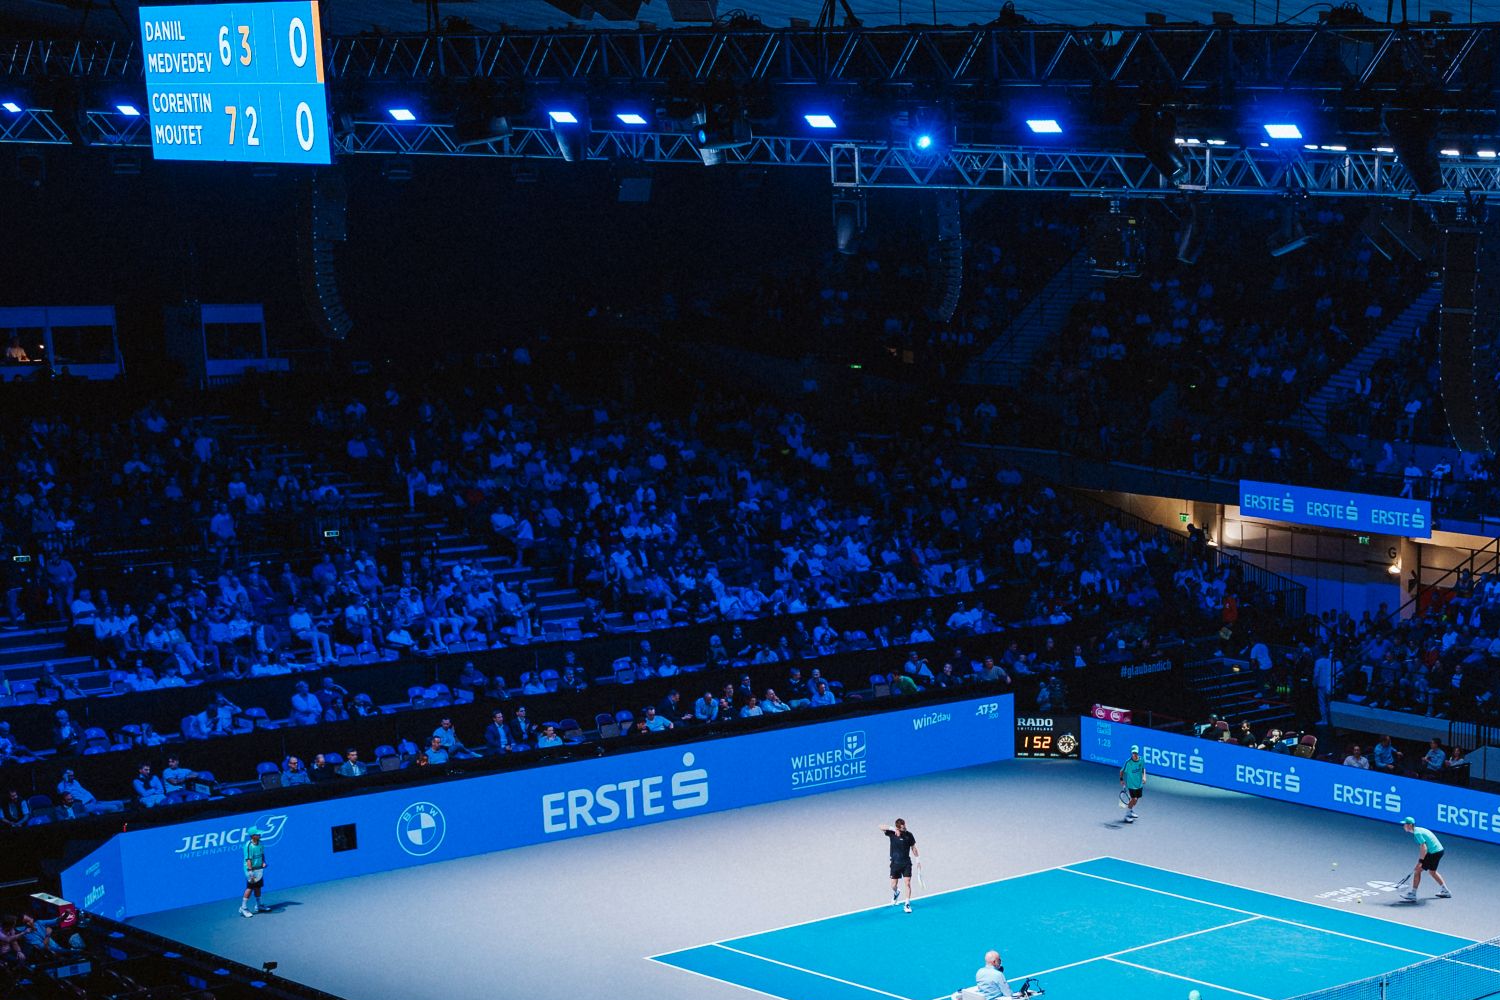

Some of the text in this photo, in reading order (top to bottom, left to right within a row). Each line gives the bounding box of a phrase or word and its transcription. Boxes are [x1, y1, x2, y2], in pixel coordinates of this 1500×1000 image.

[145, 21, 185, 41] DANIIL
[219, 17, 307, 67] 6 3 0
[148, 53, 212, 73] MEDVEDEV
[152, 93, 212, 113] CORENTIN
[155, 125, 203, 145] MOUTET
[225, 102, 314, 151] 7 2 0
[1244, 494, 1280, 511] ERSTE
[1306, 502, 1344, 520] ERSTE
[1371, 509, 1410, 528] ERSTE
[1388, 547, 1397, 559] G
[1017, 718, 1053, 727] RADO
[791, 751, 842, 769] WIENER
[1143, 746, 1186, 772] ERSTE
[792, 761, 867, 785] STÄDTISCHE
[1236, 764, 1281, 790] ERSTE
[542, 775, 664, 833] ERSTE
[1333, 784, 1382, 810] ERSTE
[1437, 803, 1488, 831] ERSTE
